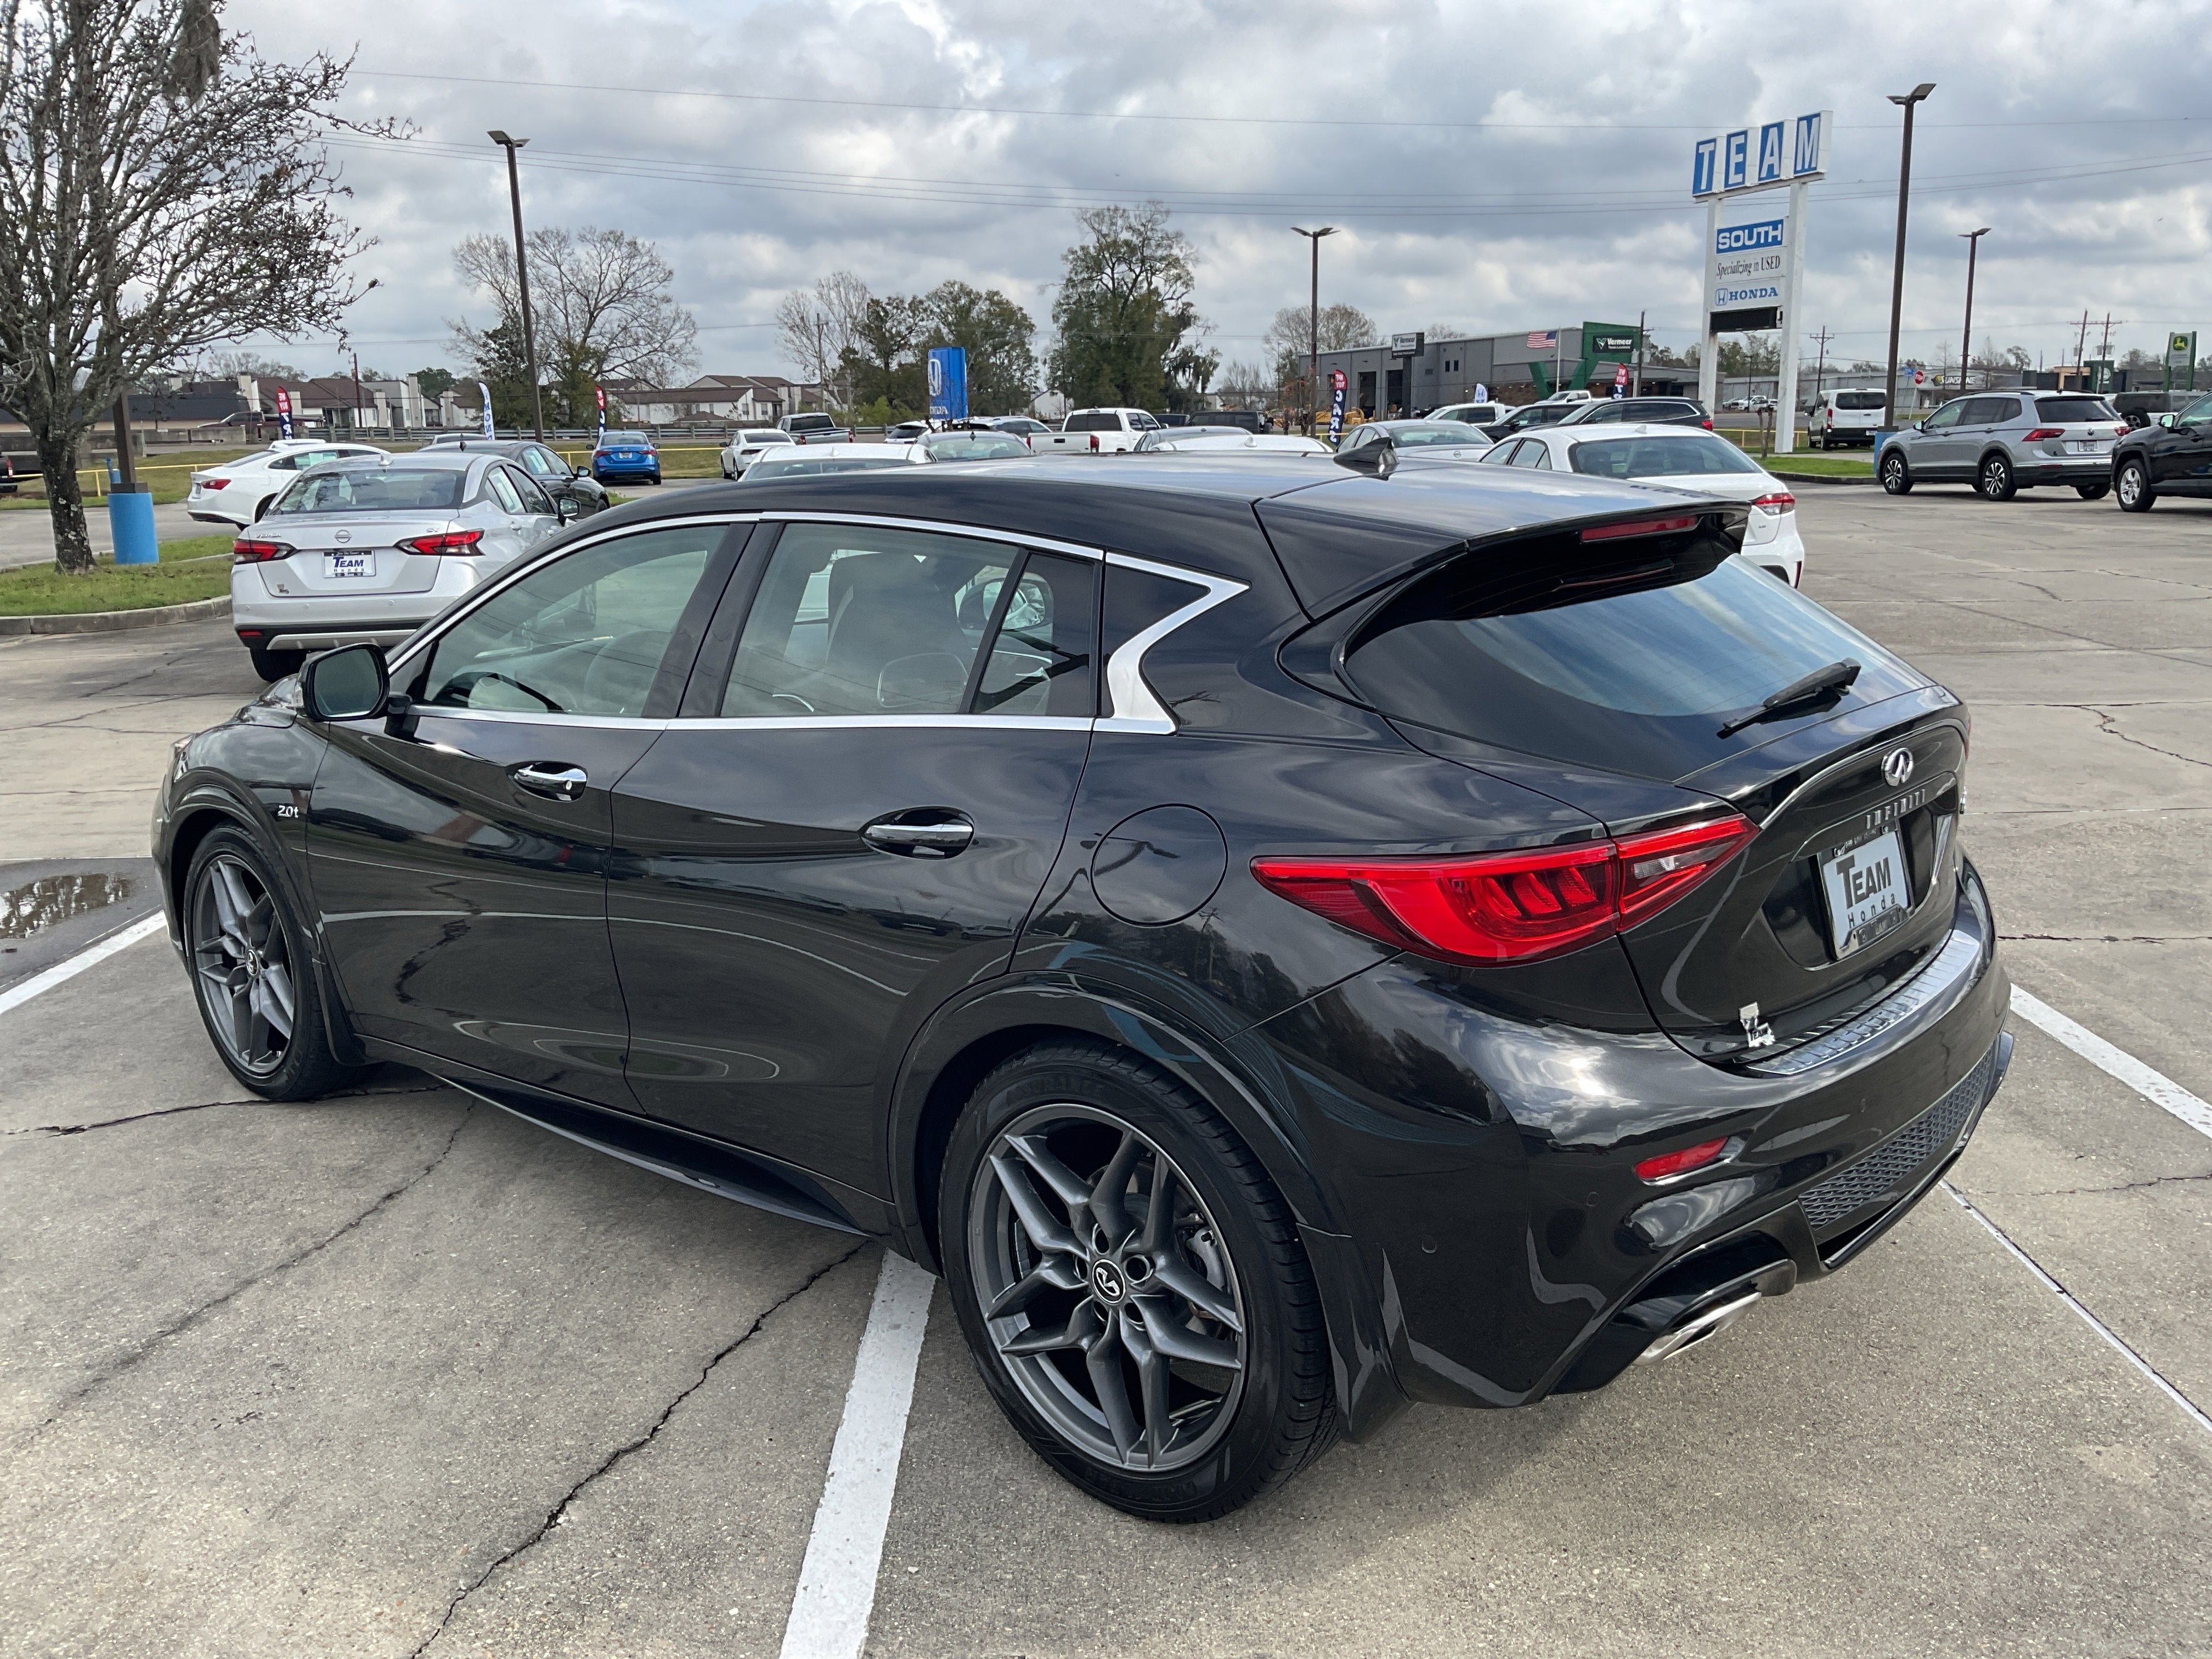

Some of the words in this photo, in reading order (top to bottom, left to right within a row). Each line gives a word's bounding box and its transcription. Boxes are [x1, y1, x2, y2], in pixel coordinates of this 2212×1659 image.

[1699, 117, 1820, 190] TEAM
[1718, 224, 1782, 249] SOUTH
[1717, 259, 1752, 279] Specializing
[1753, 258, 1759, 272] in
[1761, 255, 1780, 270] USED
[1729, 287, 1778, 301] HONDA
[333, 556, 364, 568] TEAM
[1836, 855, 1892, 909] TEAM
[1847, 893, 1895, 929] Honda
